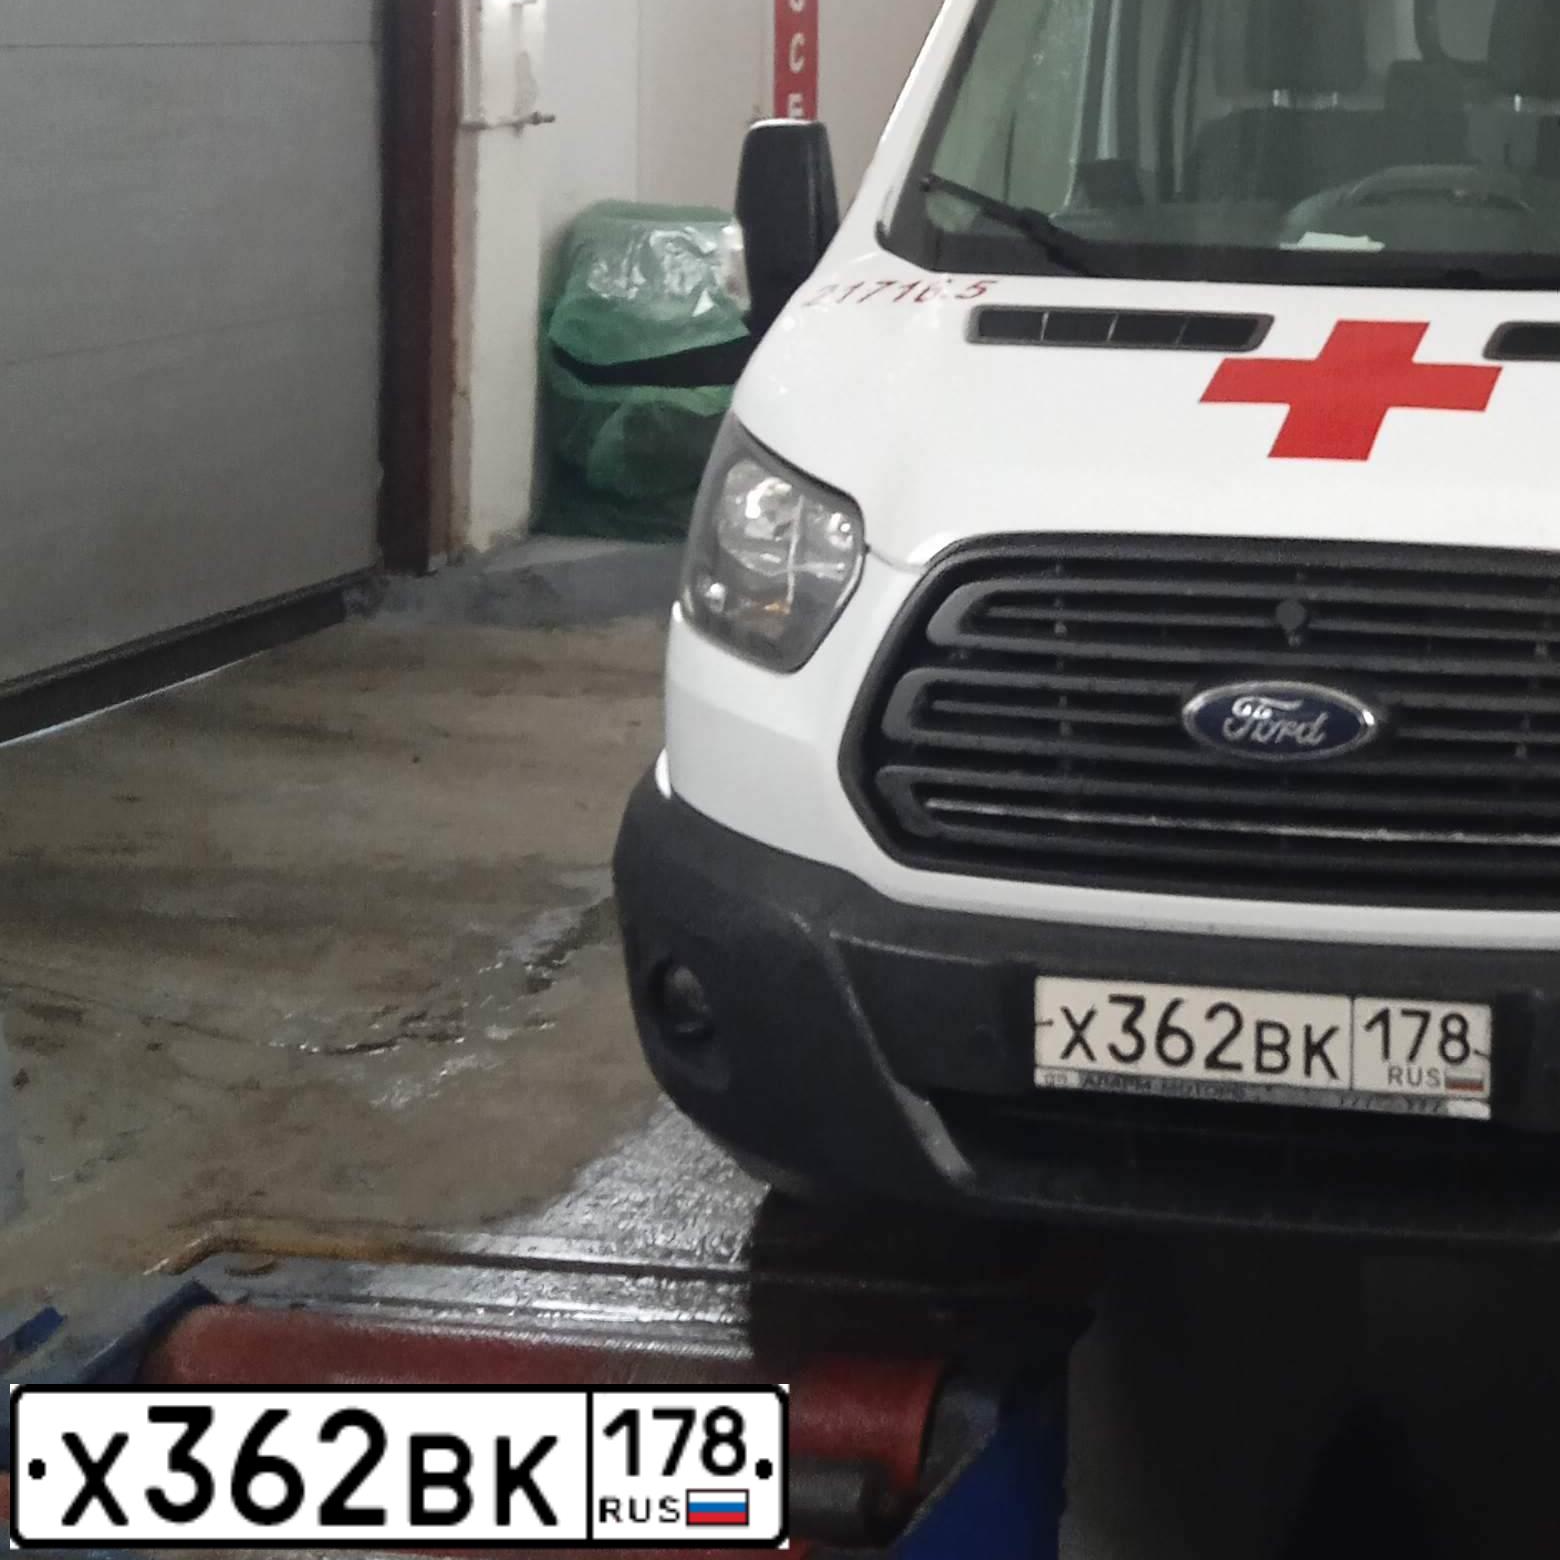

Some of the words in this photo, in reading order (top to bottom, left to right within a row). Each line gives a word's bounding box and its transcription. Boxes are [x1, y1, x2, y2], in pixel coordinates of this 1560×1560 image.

[1223, 696, 1328, 746] Ford
[1363, 1007, 1470, 1066] 178
[1388, 1064, 1441, 1088] RUS
